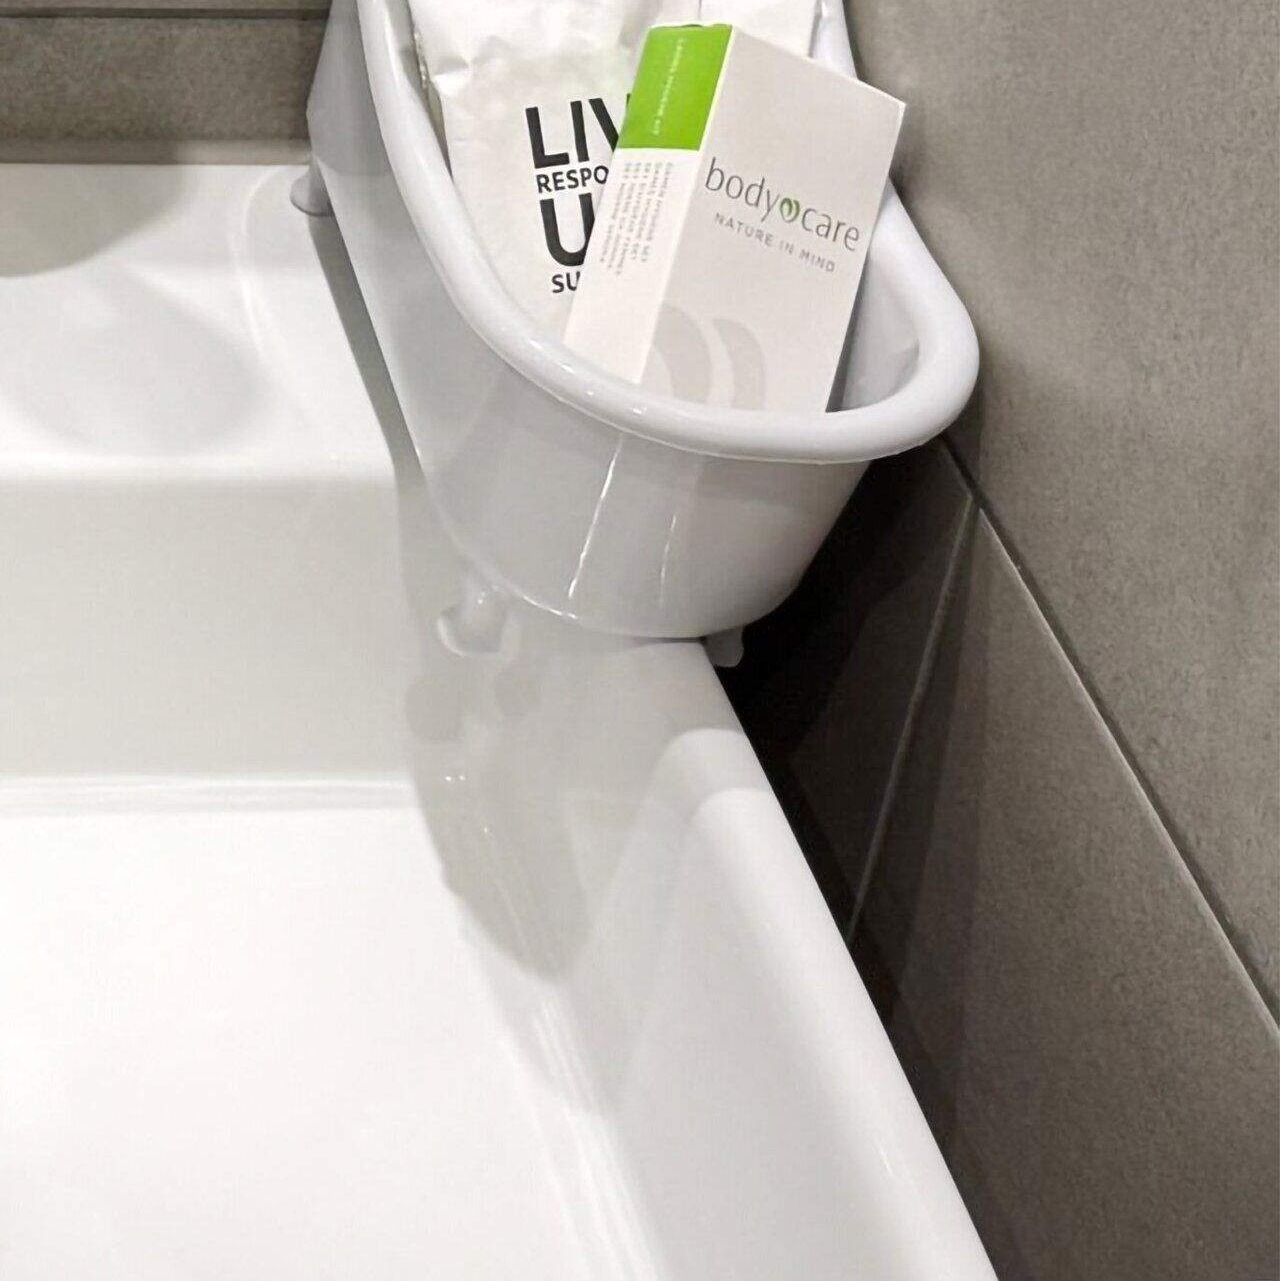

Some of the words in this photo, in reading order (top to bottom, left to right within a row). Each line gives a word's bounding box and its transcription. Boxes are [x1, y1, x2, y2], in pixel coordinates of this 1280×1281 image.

[535, 165, 609, 194] RESPO
[714, 212, 774, 247] NATURE
[779, 238, 794, 256] IN
[798, 248, 836, 273] MIND
